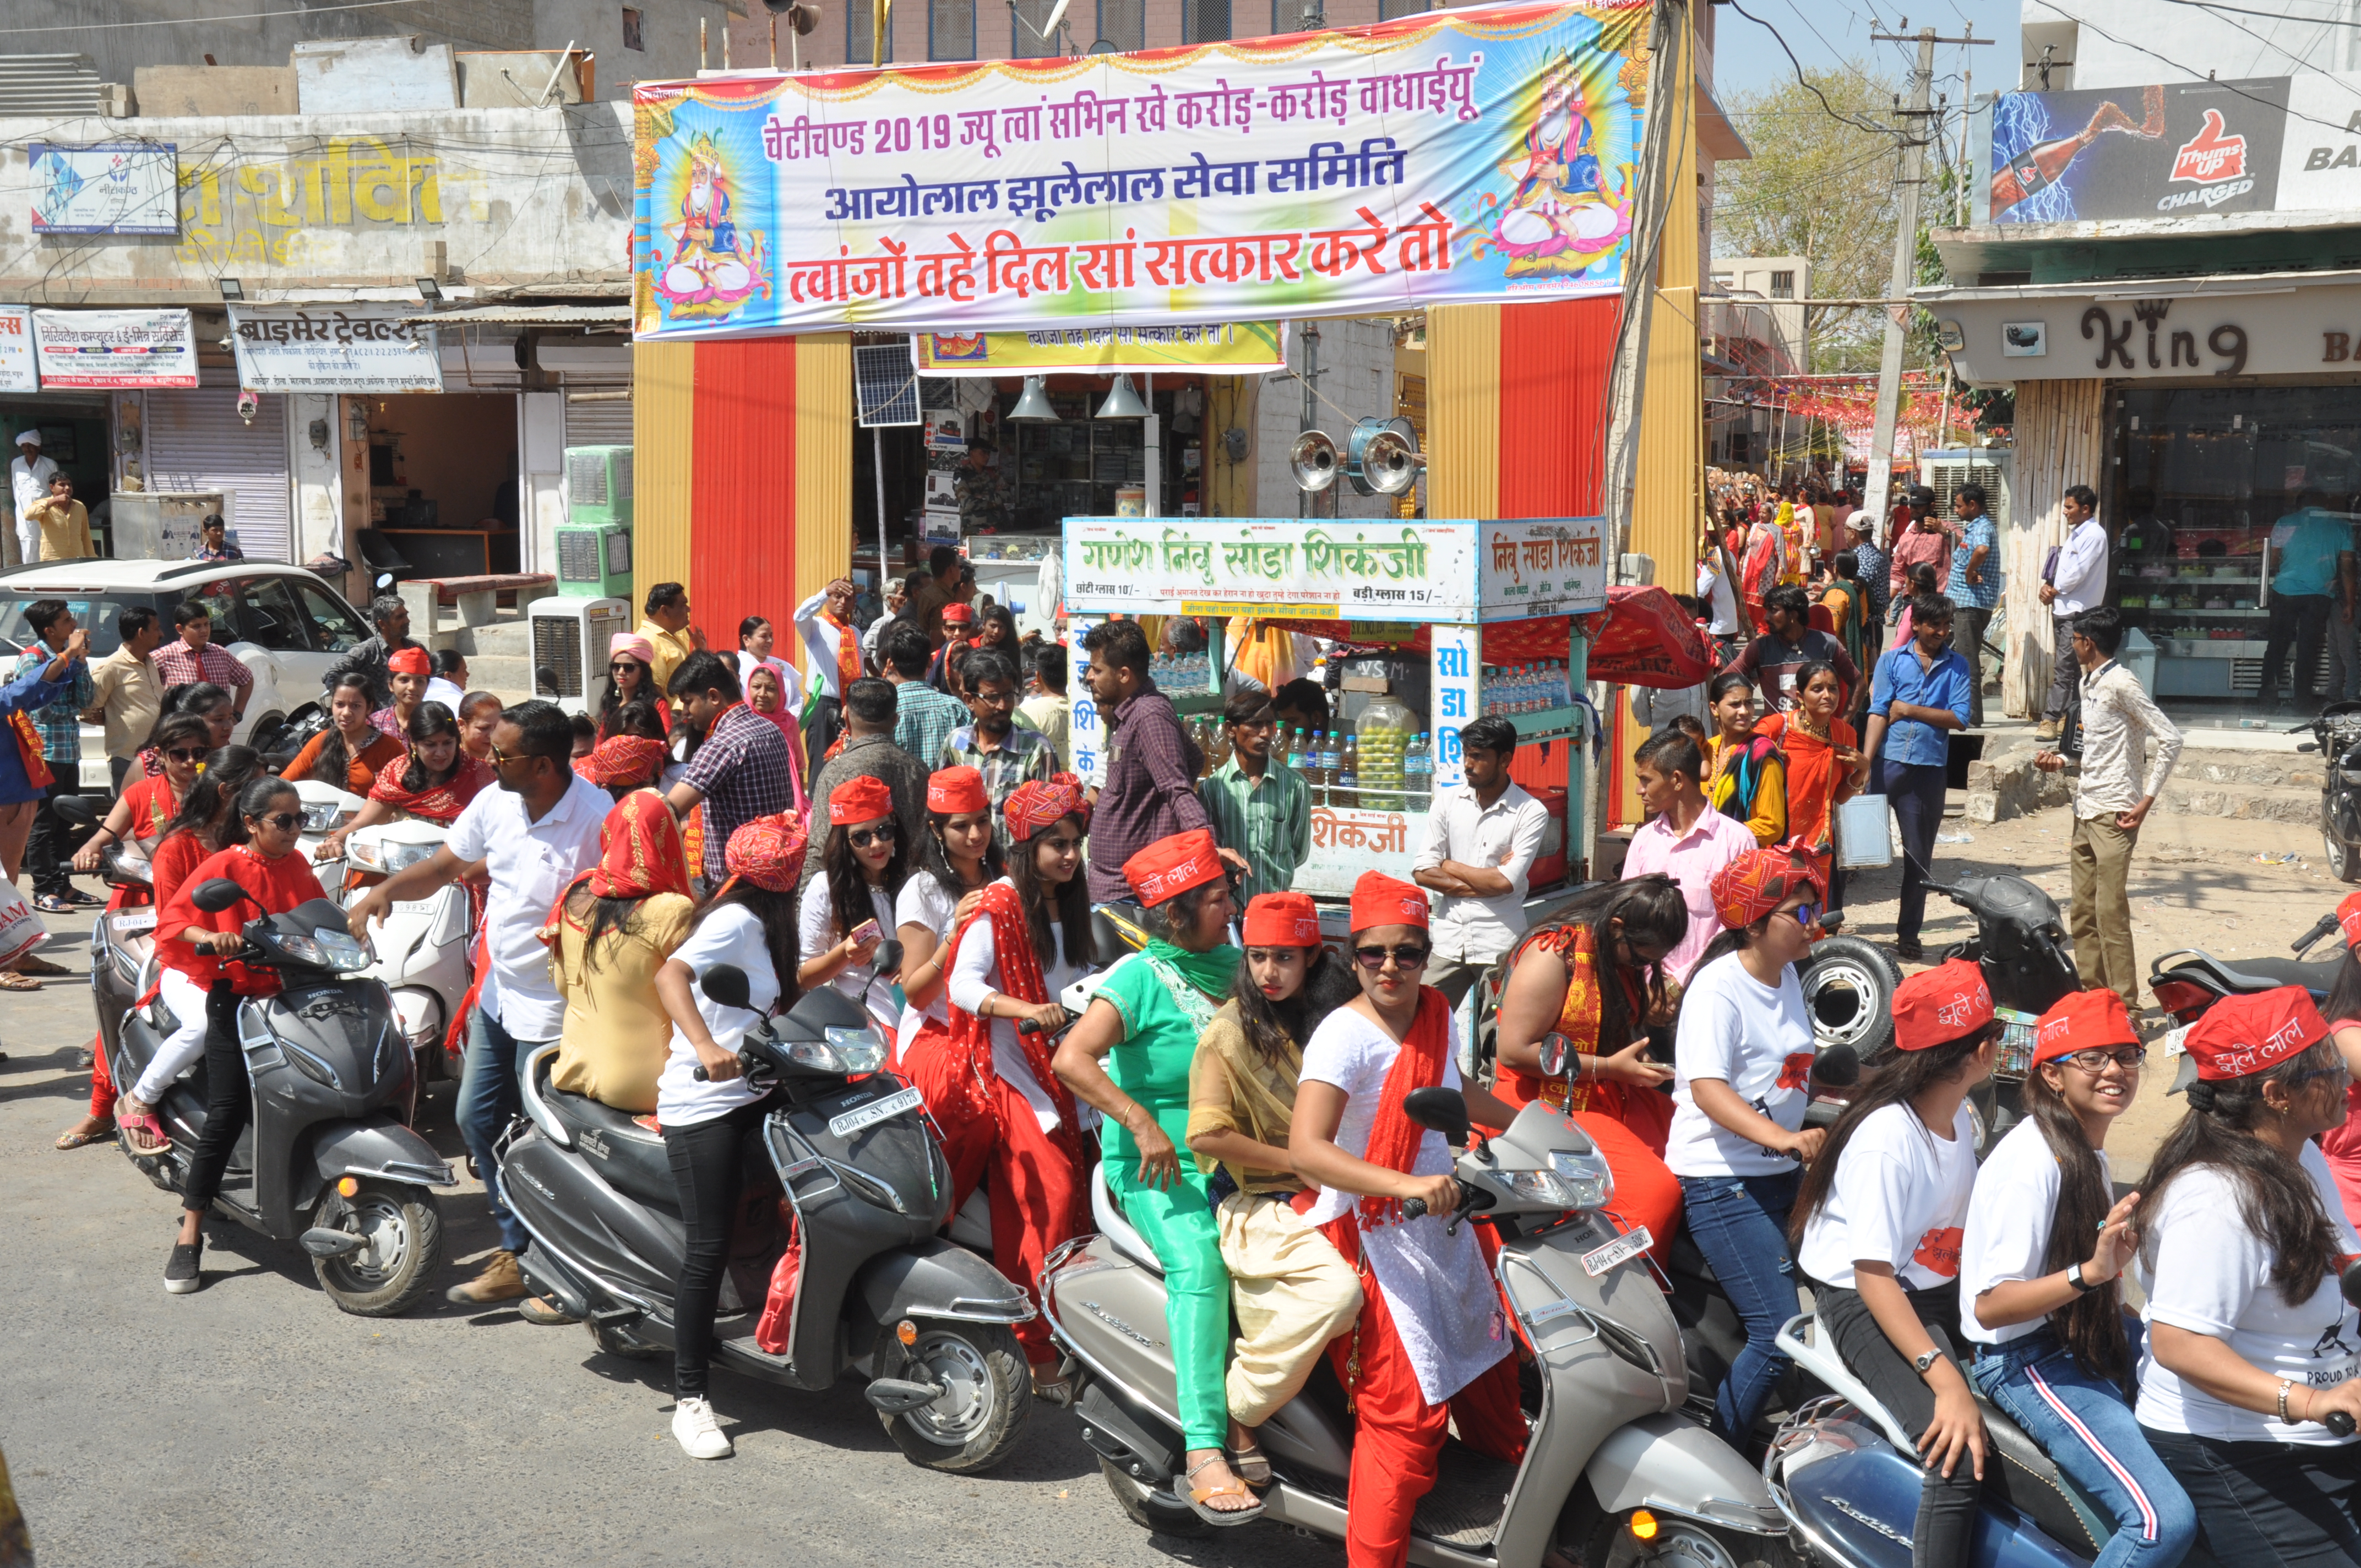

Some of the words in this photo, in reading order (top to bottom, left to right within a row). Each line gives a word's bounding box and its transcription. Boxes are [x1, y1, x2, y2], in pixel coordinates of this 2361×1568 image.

[764, 115, 867, 160] चेटीचण्ड
[875, 114, 951, 154] 2019
[959, 110, 1001, 159] ज्यू
[1002, 95, 1041, 143] त्वां
[1049, 90, 1128, 140] सभिन
[1135, 84, 1167, 132] खे
[2180, 145, 2241, 169] Thums
[2196, 157, 2225, 177] UP
[2304, 145, 2361, 171] BA
[825, 173, 1000, 220] आयोलाल
[1008, 161, 1165, 222] झूलेलाल
[1173, 152, 1258, 199] सेवा
[1266, 138, 1407, 192] समिति
[2157, 179, 2254, 211] CHARGED
[788, 237, 907, 303] त्वांजों
[915, 232, 976, 301] तहे
[984, 229, 1069, 298] दिल
[1076, 227, 1135, 289] सां
[1144, 232, 1302, 286] सत्कार
[1310, 206, 1388, 276] करे
[1397, 202, 1452, 271] तो
[1563, 279, 1615, 288] 9460885617
[41, 326, 79, 342] निखिलेश
[80, 330, 114, 347] कम्प्यूटर
[117, 331, 122, 342] &
[123, 326, 150, 345] ई-मित्र
[239, 312, 331, 345] बाड़मेर
[2081, 306, 2248, 378] King
[1080, 529, 1153, 574] गणेश
[1158, 527, 1215, 586] निंबु
[1221, 529, 1294, 580] सोडा
[1301, 527, 1429, 581] शिकंजी
[1491, 532, 1519, 584] निंबु
[1076, 581, 1094, 595] छोटी
[1160, 586, 1174, 597] पराई
[1176, 589, 1198, 597] अमानत
[1199, 587, 1211, 597] देख
[1248, 589, 1254, 598] हो
[1287, 589, 1299, 599] देगा
[1301, 589, 1321, 599] परेशान
[1324, 591, 1331, 600] ना
[1333, 590, 1340, 600] हो
[1375, 589, 1406, 600] ग्लास
[67, 602, 86, 611] ollege
[1311, 808, 1407, 853] शिकंजी
[307, 989, 344, 999] HONDA
[2260, 1016, 2305, 1058] लाल
[841, 1091, 874, 1108] HONDA
[897, 1092, 918, 1108] 9173
[2307, 1371, 2342, 1385] PROUD
